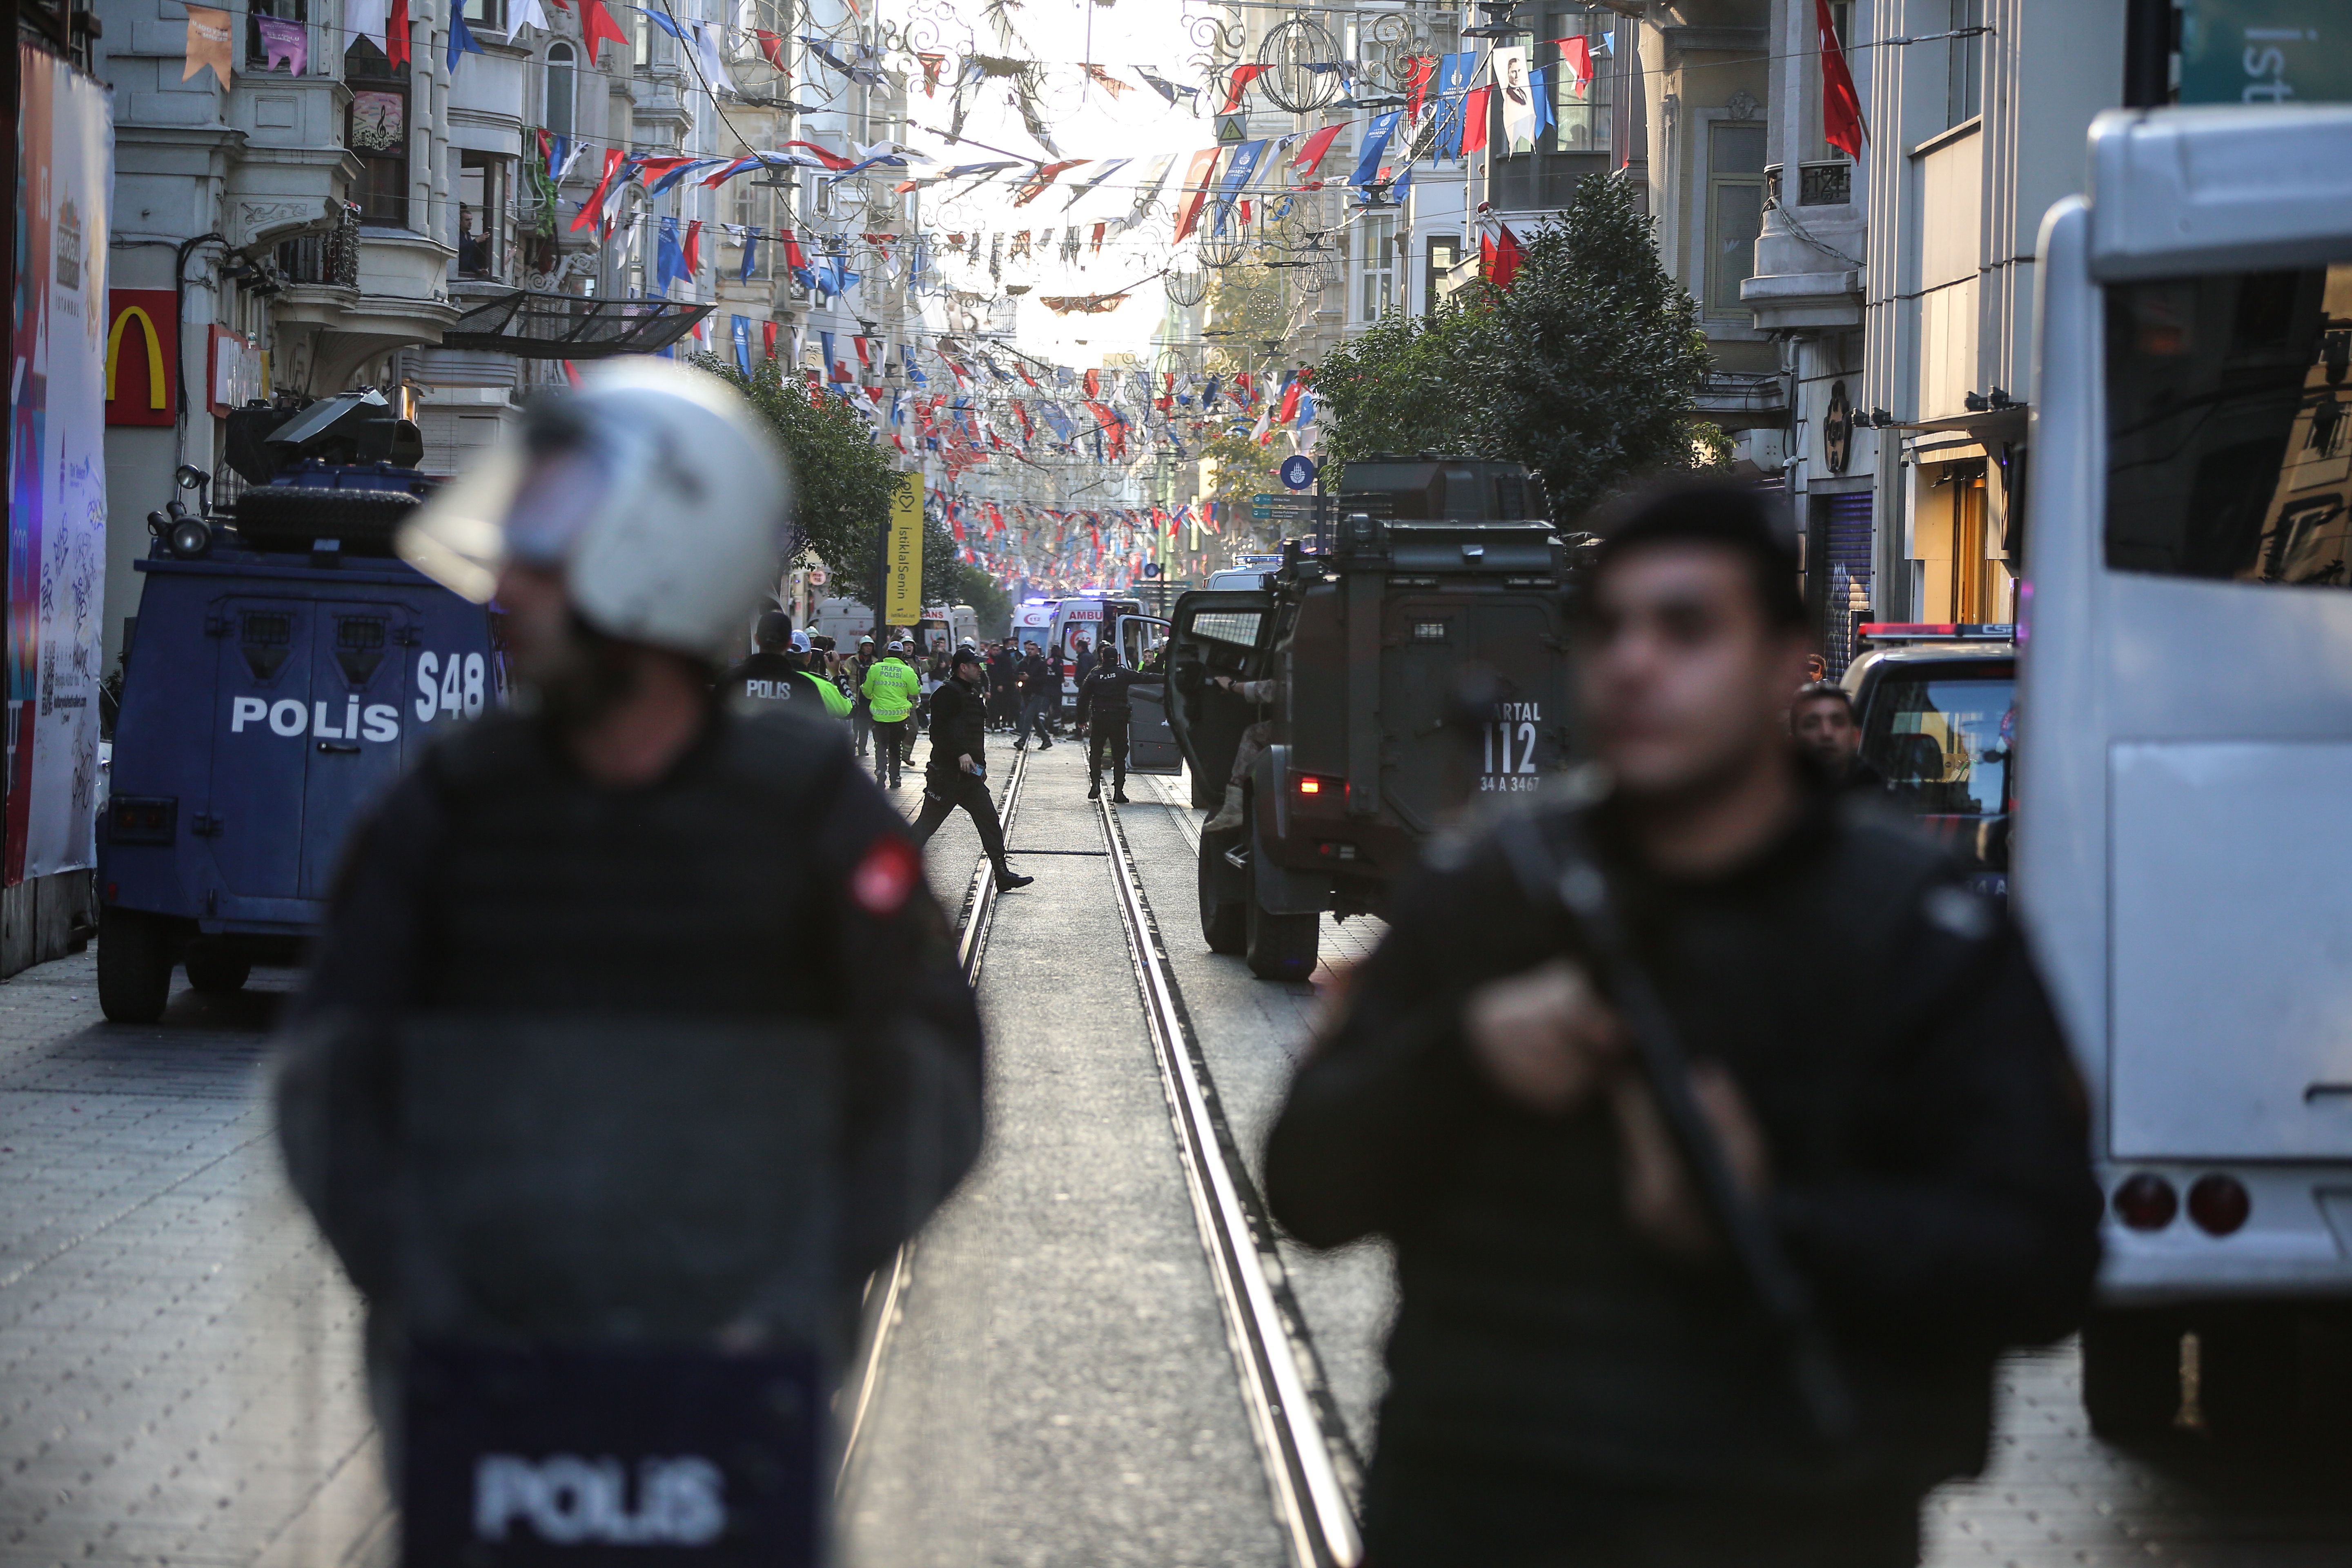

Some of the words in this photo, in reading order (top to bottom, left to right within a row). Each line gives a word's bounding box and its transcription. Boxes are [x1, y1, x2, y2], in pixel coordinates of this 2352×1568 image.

[897, 527, 912, 599] İstiklalSenin
[415, 651, 485, 722] S48
[746, 679, 791, 700] POLIS
[879, 671, 902, 679] POLİSİ
[231, 695, 399, 742] POLİS
[1483, 722, 1536, 773] 112
[1480, 777, 1494, 791] 34
[1499, 777, 1507, 791] A
[1511, 777, 1540, 791] 3467
